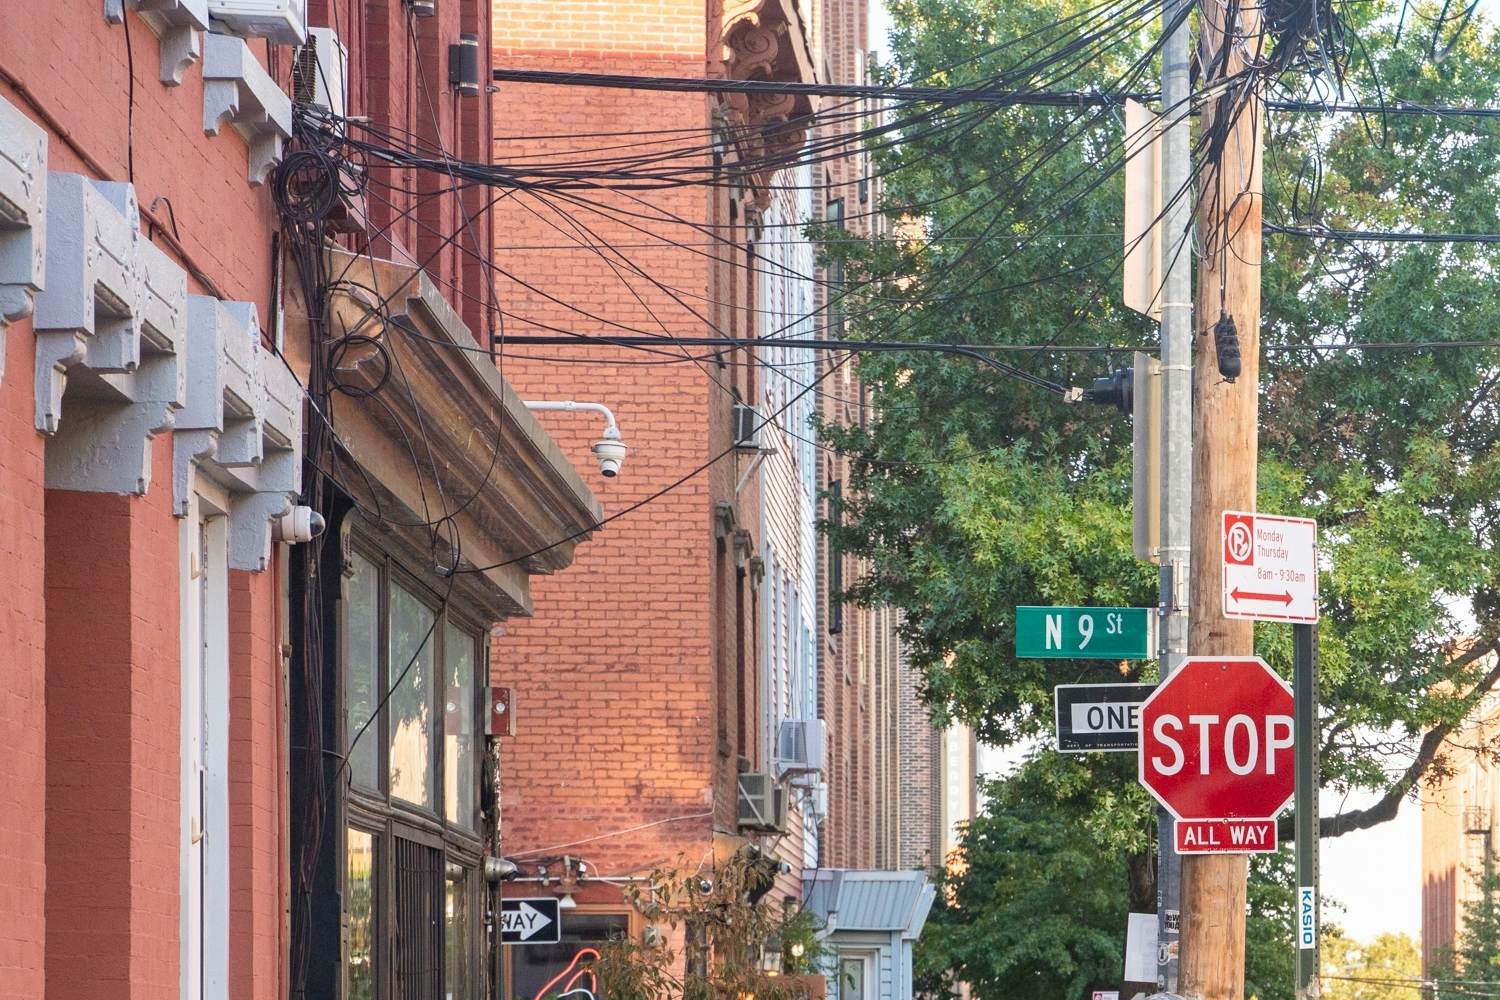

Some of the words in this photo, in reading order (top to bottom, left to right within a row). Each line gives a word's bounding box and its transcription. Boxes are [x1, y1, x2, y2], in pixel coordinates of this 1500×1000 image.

[1257, 529, 1284, 544] Monday
[1257, 545, 1289, 561] Thursday
[1257, 567, 1273, 581] 8am
[1045, 614, 1062, 650] N
[1078, 614, 1094, 650] 9
[1106, 612, 1123, 634] St
[1087, 705, 1139, 730] ONE
[1151, 713, 1295, 777] STOP
[1184, 826, 1221, 846] ALL
[1229, 825, 1269, 846] WAY
[1302, 890, 1313, 945] KASIO
